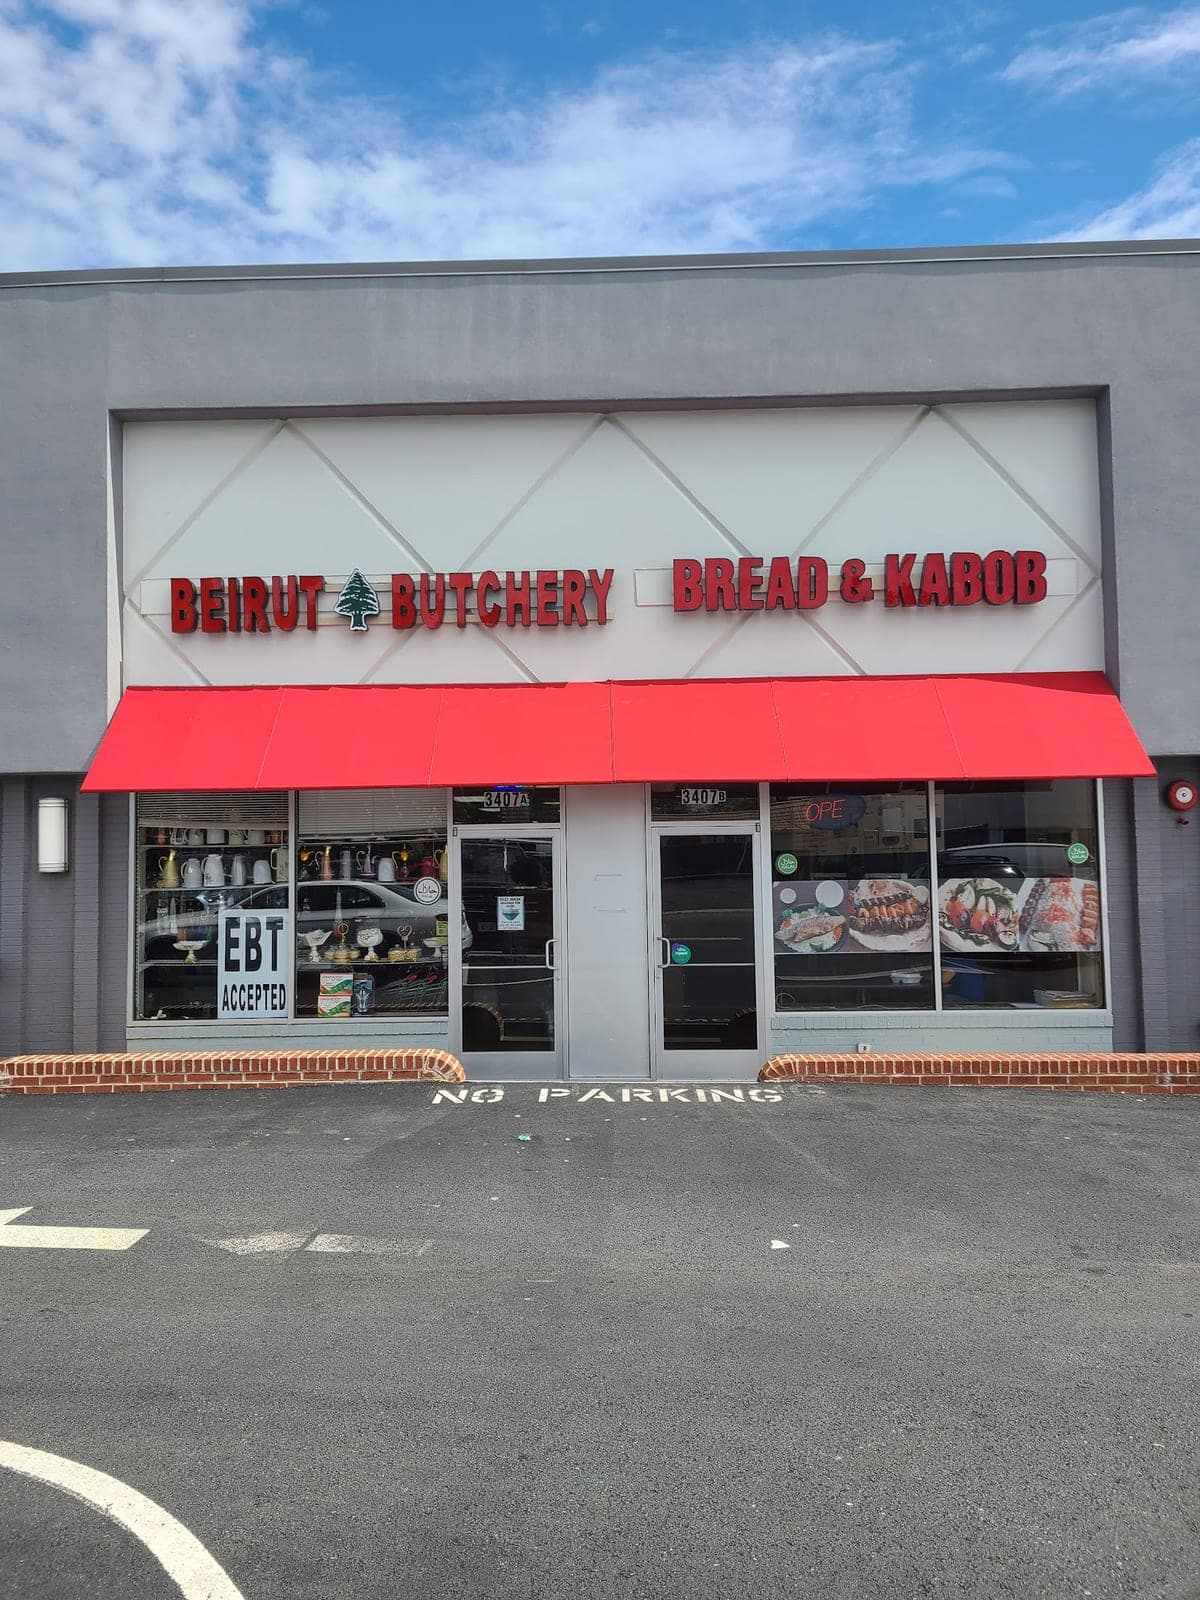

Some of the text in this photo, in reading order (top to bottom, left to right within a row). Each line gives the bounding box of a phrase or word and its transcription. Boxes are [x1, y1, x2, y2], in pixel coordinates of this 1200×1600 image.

[170, 568, 615, 633] BEIRUT BUTCHERY
[672, 549, 1047, 612] BREAD & KABOB
[682, 789, 726, 804] 3407B
[224, 916, 284, 972] EBT
[222, 983, 286, 1011] ACCEPTED
[431, 1087, 783, 1104] NO PARKING
